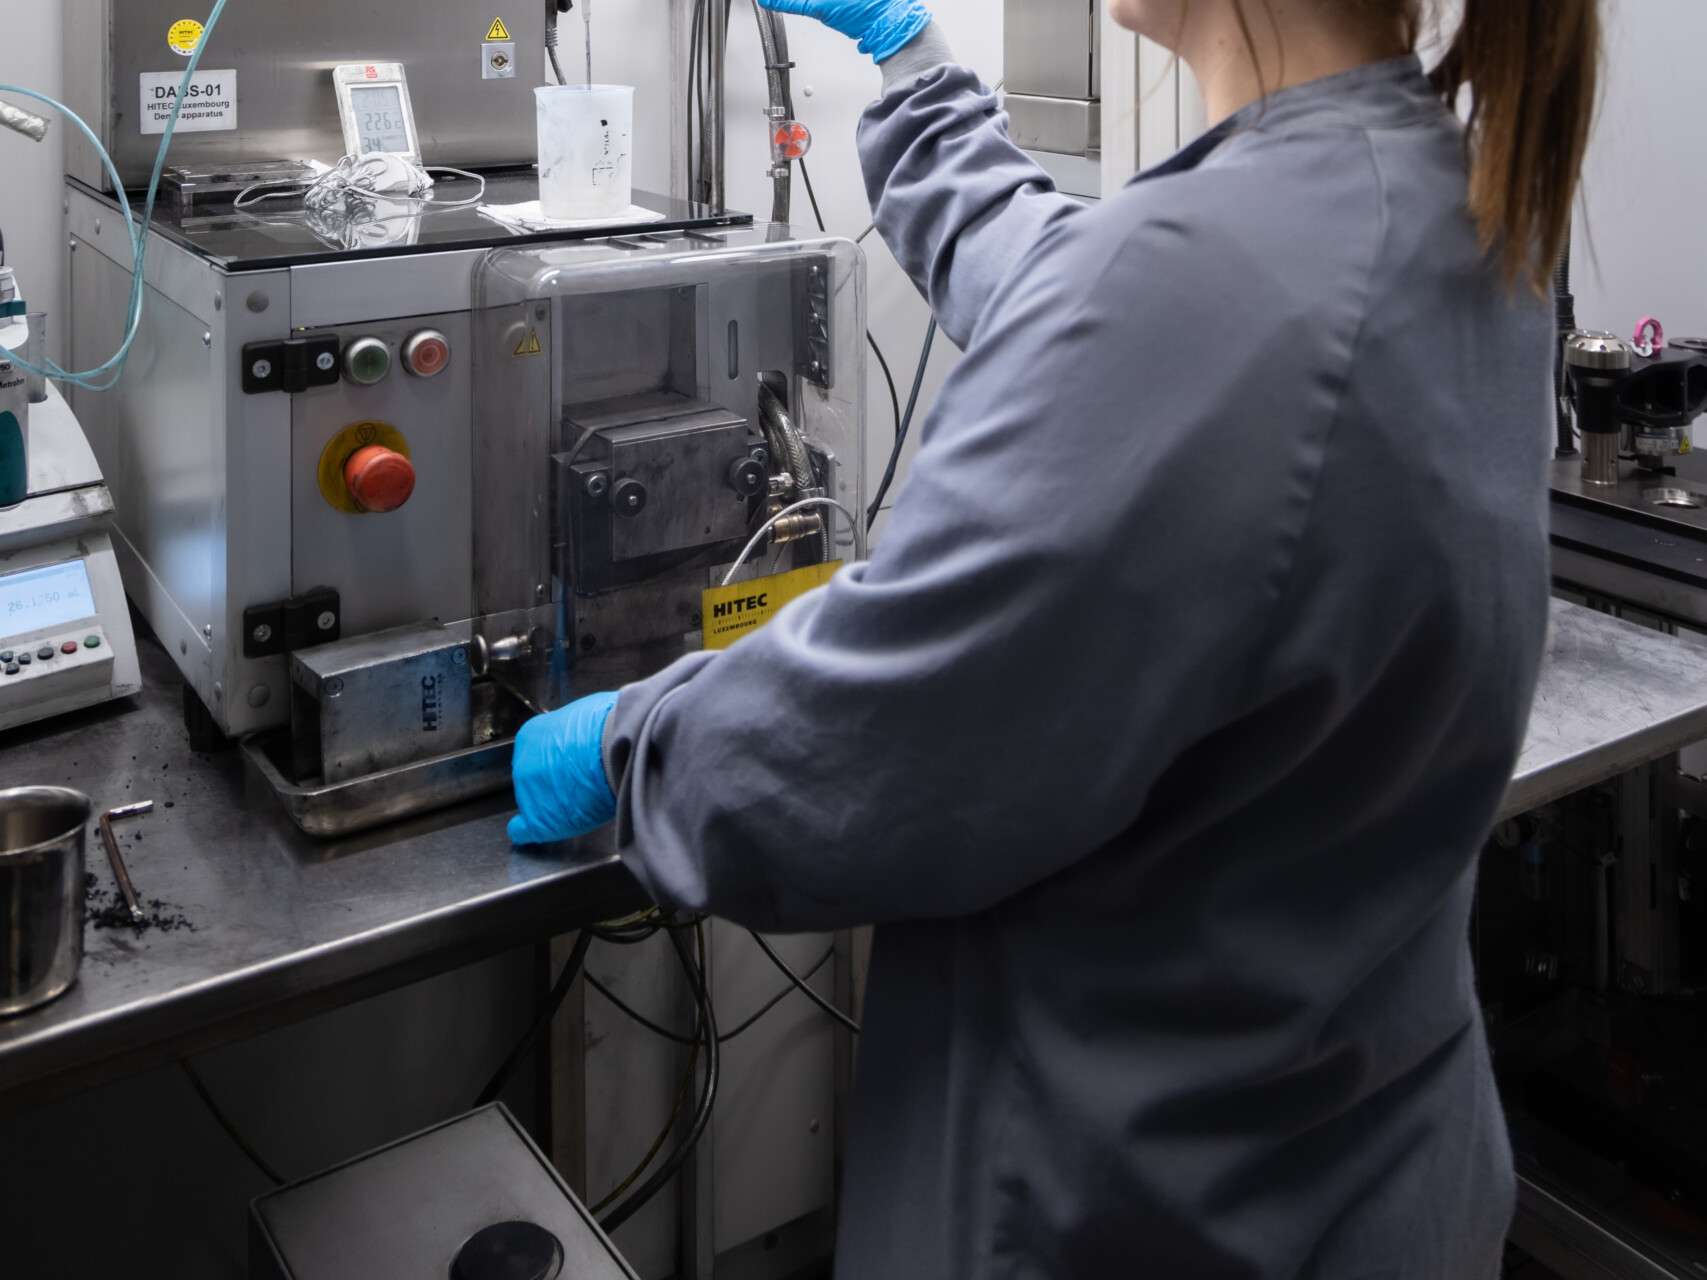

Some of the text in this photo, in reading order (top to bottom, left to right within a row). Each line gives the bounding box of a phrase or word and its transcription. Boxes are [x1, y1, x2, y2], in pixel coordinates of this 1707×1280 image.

[155, 84, 221, 98] DAS-01
[147, 102, 174, 110] HITEC
[181, 111, 223, 120] apparatus
[713, 593, 767, 618] HITEC
[713, 619, 757, 634] LUXEMBOURG
[421, 675, 437, 731] HITEC
